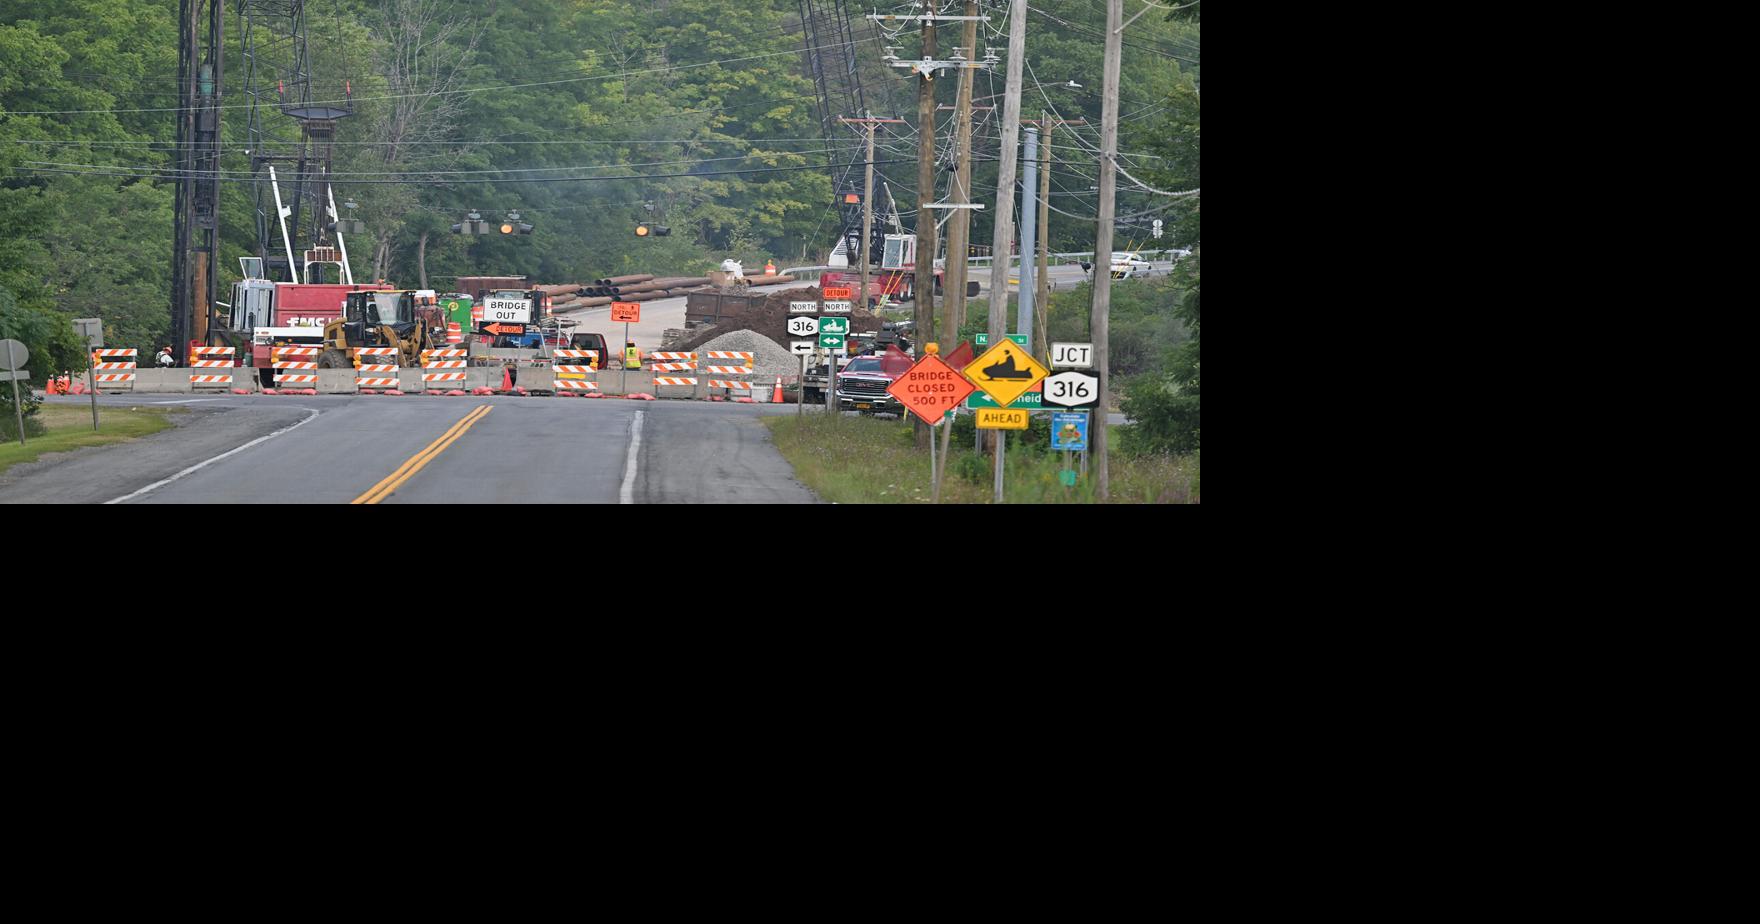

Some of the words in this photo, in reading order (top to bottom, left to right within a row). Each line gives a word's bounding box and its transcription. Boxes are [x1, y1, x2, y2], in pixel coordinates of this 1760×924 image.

[490, 301, 526, 310] BRIDGE
[496, 311, 516, 320] OUT
[792, 321, 814, 332] 316
[1055, 347, 1089, 362] JCT
[910, 371, 953, 381] BRIDGE
[907, 383, 955, 393] CLOSED
[1053, 380, 1089, 398] 316
[913, 396, 936, 405] 500
[941, 396, 955, 405] FT
[983, 413, 1022, 424] AHEAD
